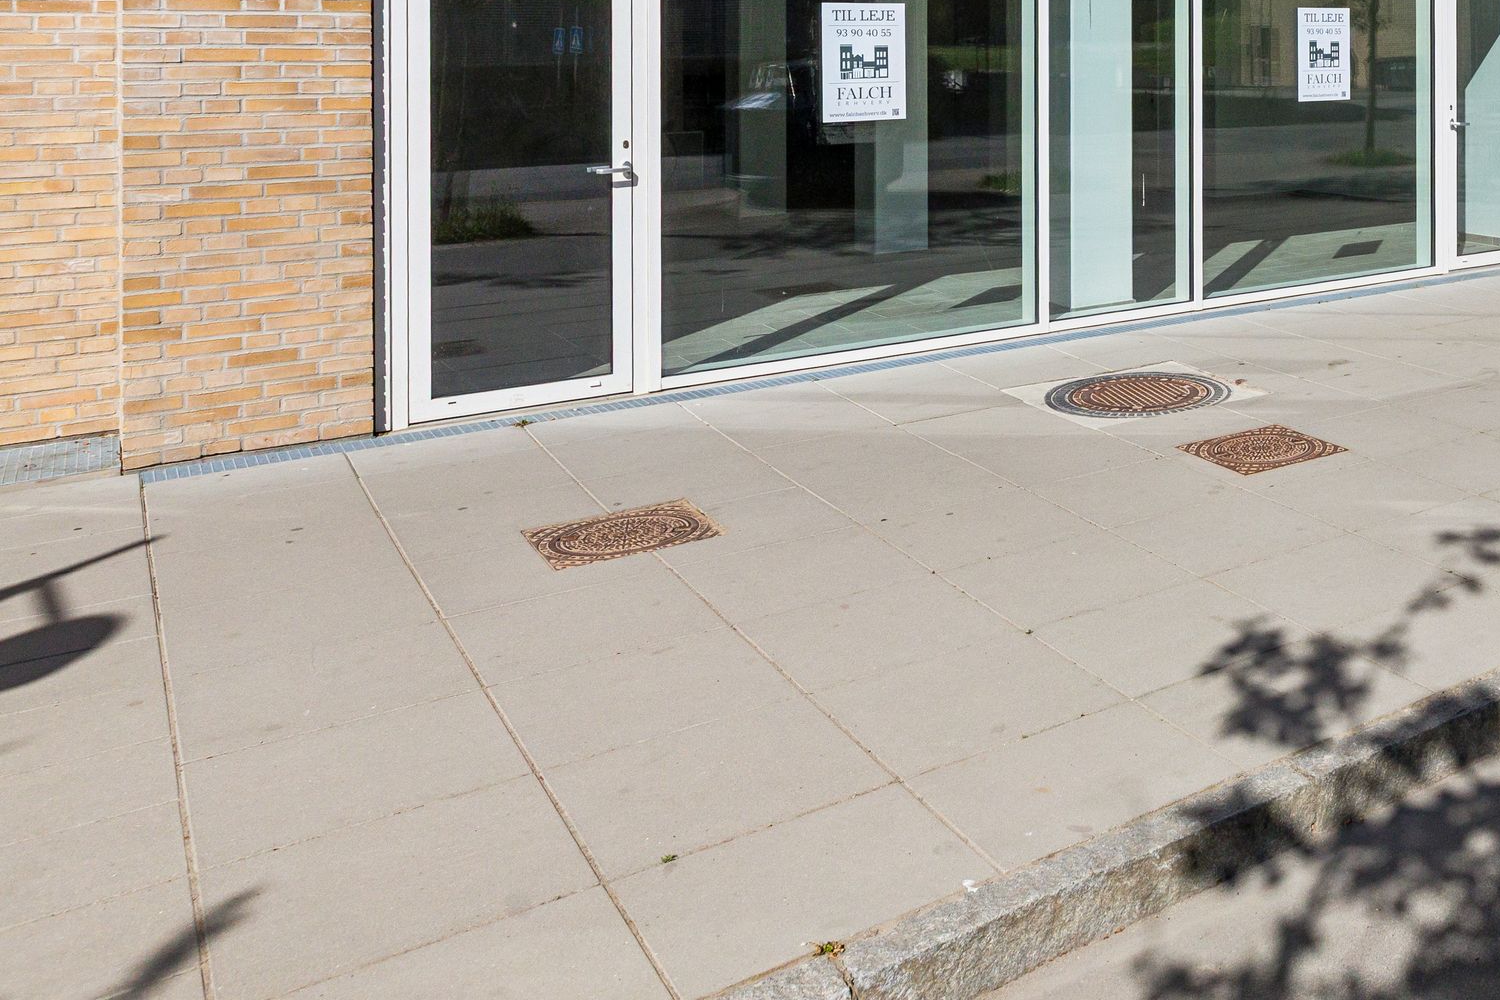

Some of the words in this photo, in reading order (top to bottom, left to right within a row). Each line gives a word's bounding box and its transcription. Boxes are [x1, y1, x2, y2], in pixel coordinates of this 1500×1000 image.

[832, 9, 856, 21] TIL
[860, 9, 895, 21] LEJE
[1304, 13, 1319, 23] TIL
[1321, 13, 1344, 23] LEJE
[836, 28, 848, 37] 93
[851, 28, 863, 37] 90
[866, 28, 878, 37] 40
[881, 28, 892, 37] 55
[1307, 73, 1342, 84] FALCH
[837, 86, 892, 100] FALCH
